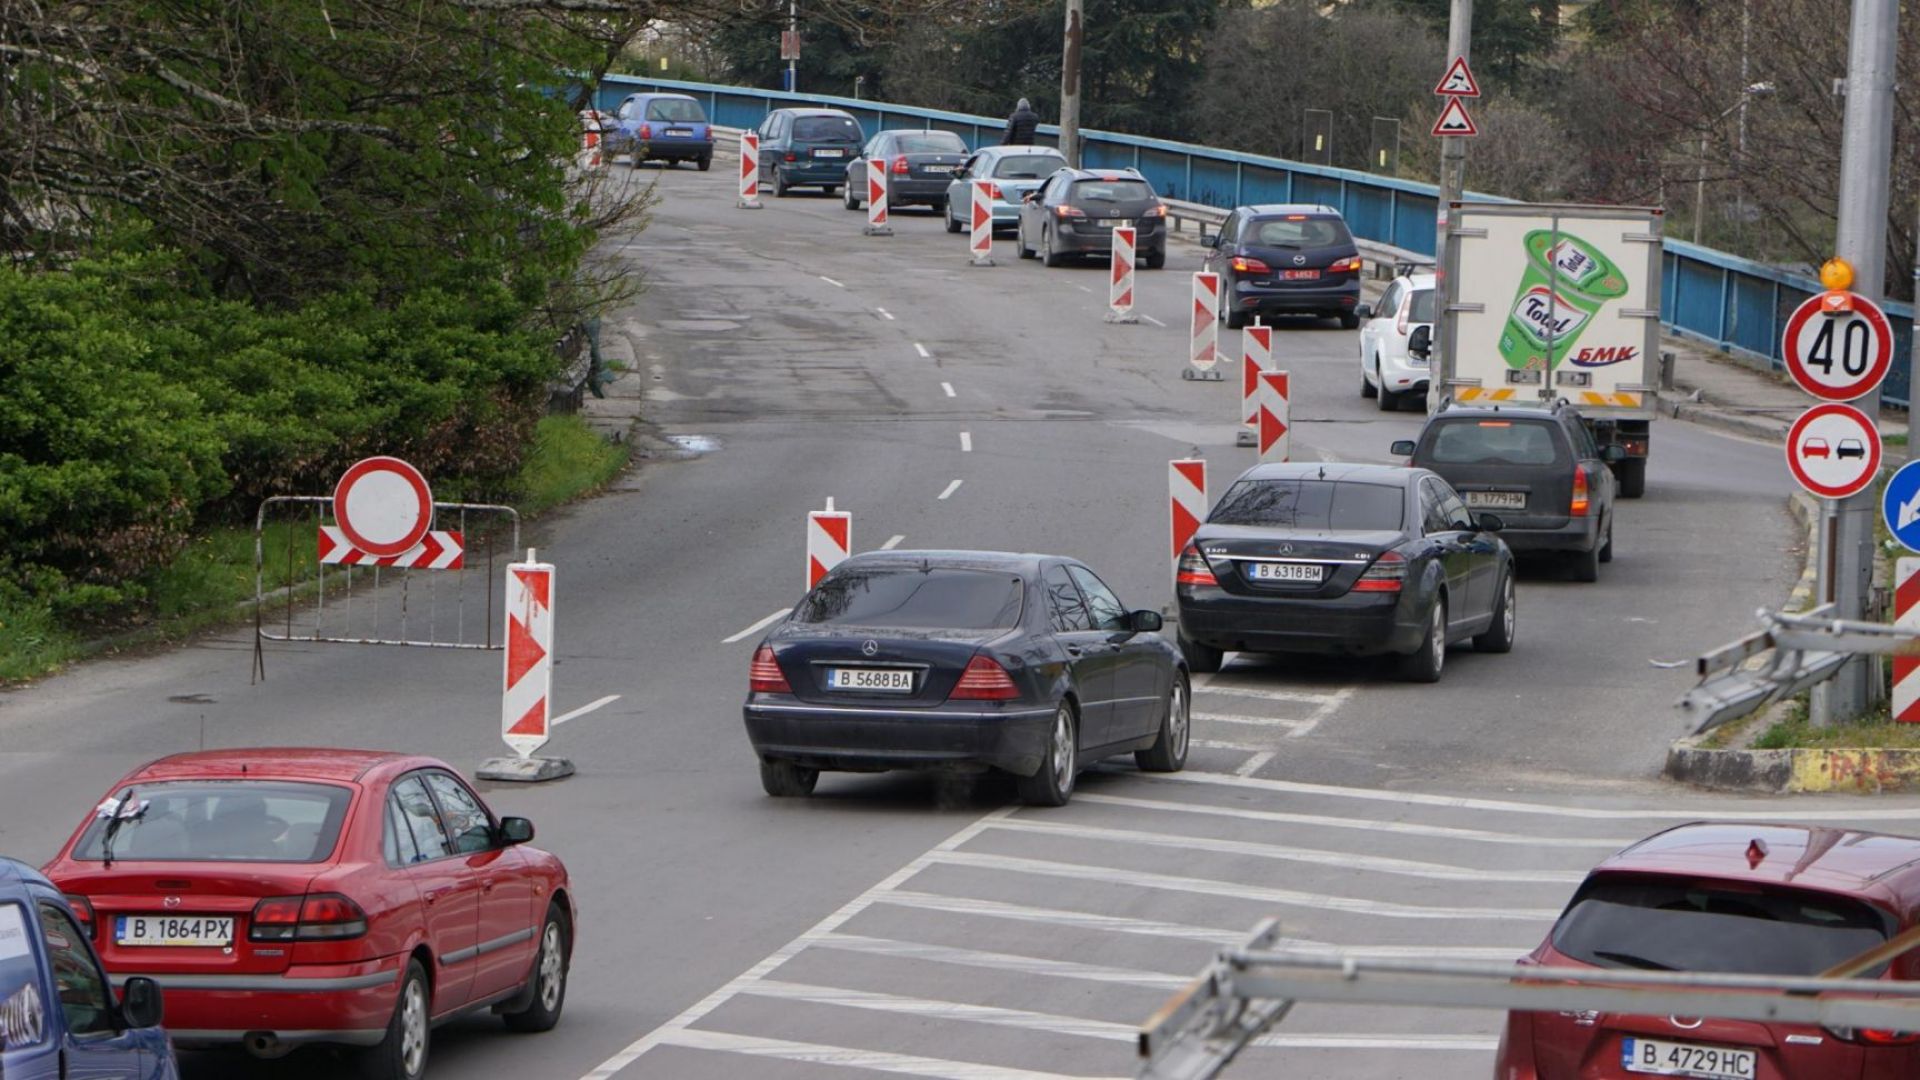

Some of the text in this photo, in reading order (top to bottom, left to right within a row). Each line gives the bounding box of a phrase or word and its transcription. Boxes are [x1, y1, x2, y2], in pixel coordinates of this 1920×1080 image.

[1525, 297, 1572, 333] Total
[1577, 346, 1636, 362] БМК
[1807, 318, 1871, 377] 40
[1261, 565, 1269, 577] B
[841, 671, 850, 686] B
[134, 919, 146, 939] B
[1643, 1043, 1657, 1065] B
